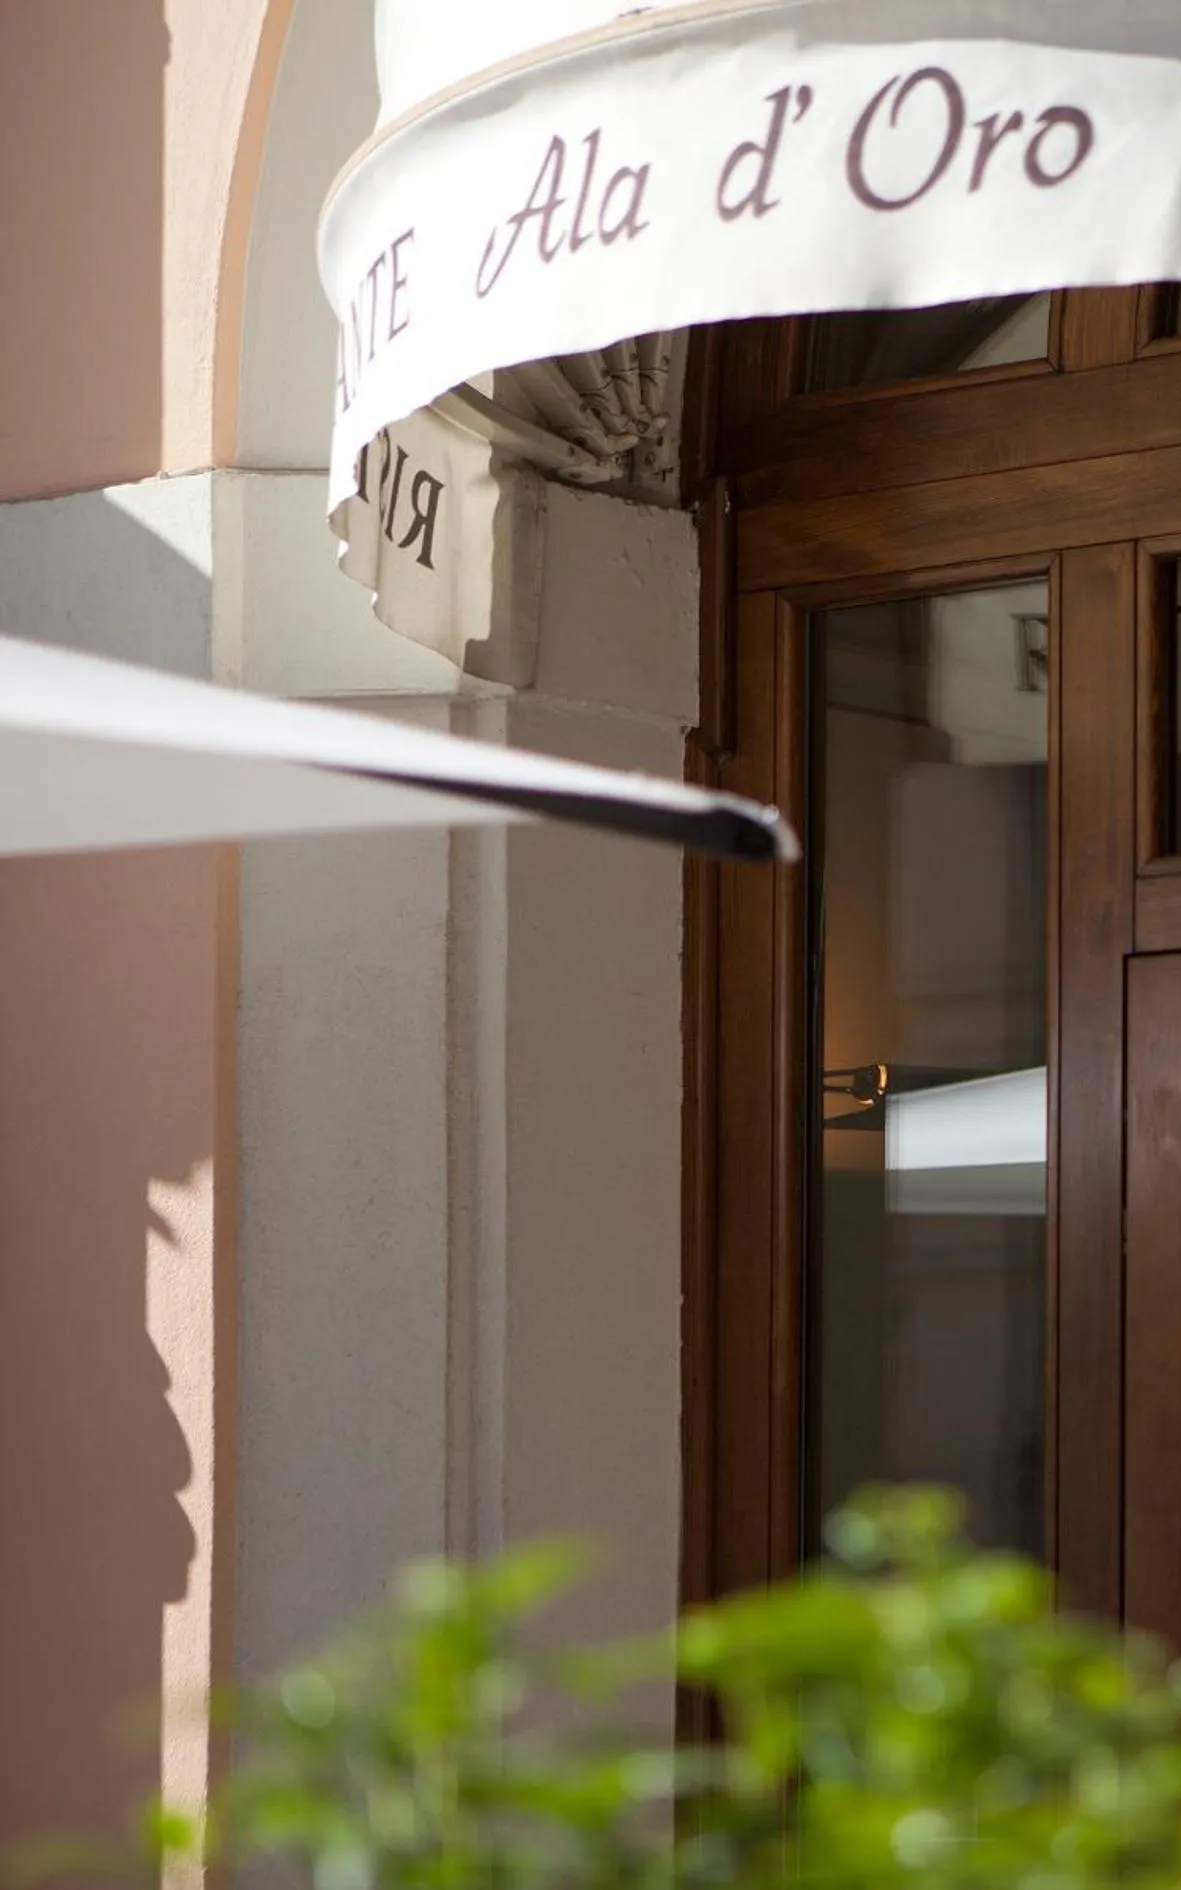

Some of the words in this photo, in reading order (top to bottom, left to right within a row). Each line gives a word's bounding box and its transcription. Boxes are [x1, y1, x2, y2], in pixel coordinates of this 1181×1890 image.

[475, 127, 652, 299] Ala
[716, 84, 813, 222] d'
[846, 66, 1094, 212] Oro
